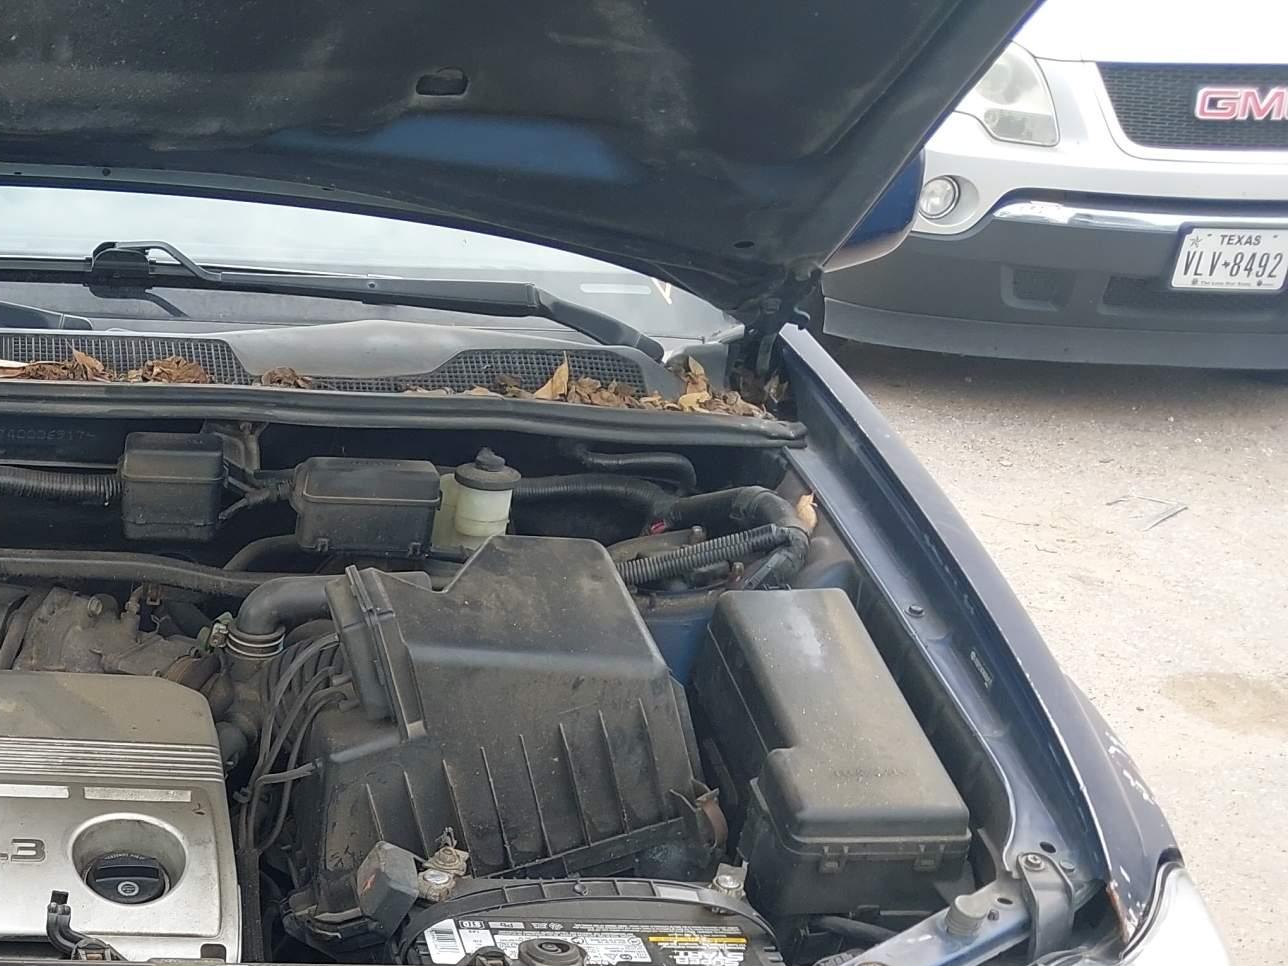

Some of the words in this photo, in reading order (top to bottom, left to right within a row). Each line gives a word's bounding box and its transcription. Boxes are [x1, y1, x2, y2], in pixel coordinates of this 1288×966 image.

[1194, 87, 1288, 120] GM
[1220, 234, 1262, 246] TEXAS
[1183, 251, 1222, 277] VLV
[1229, 252, 1283, 278] 8492
